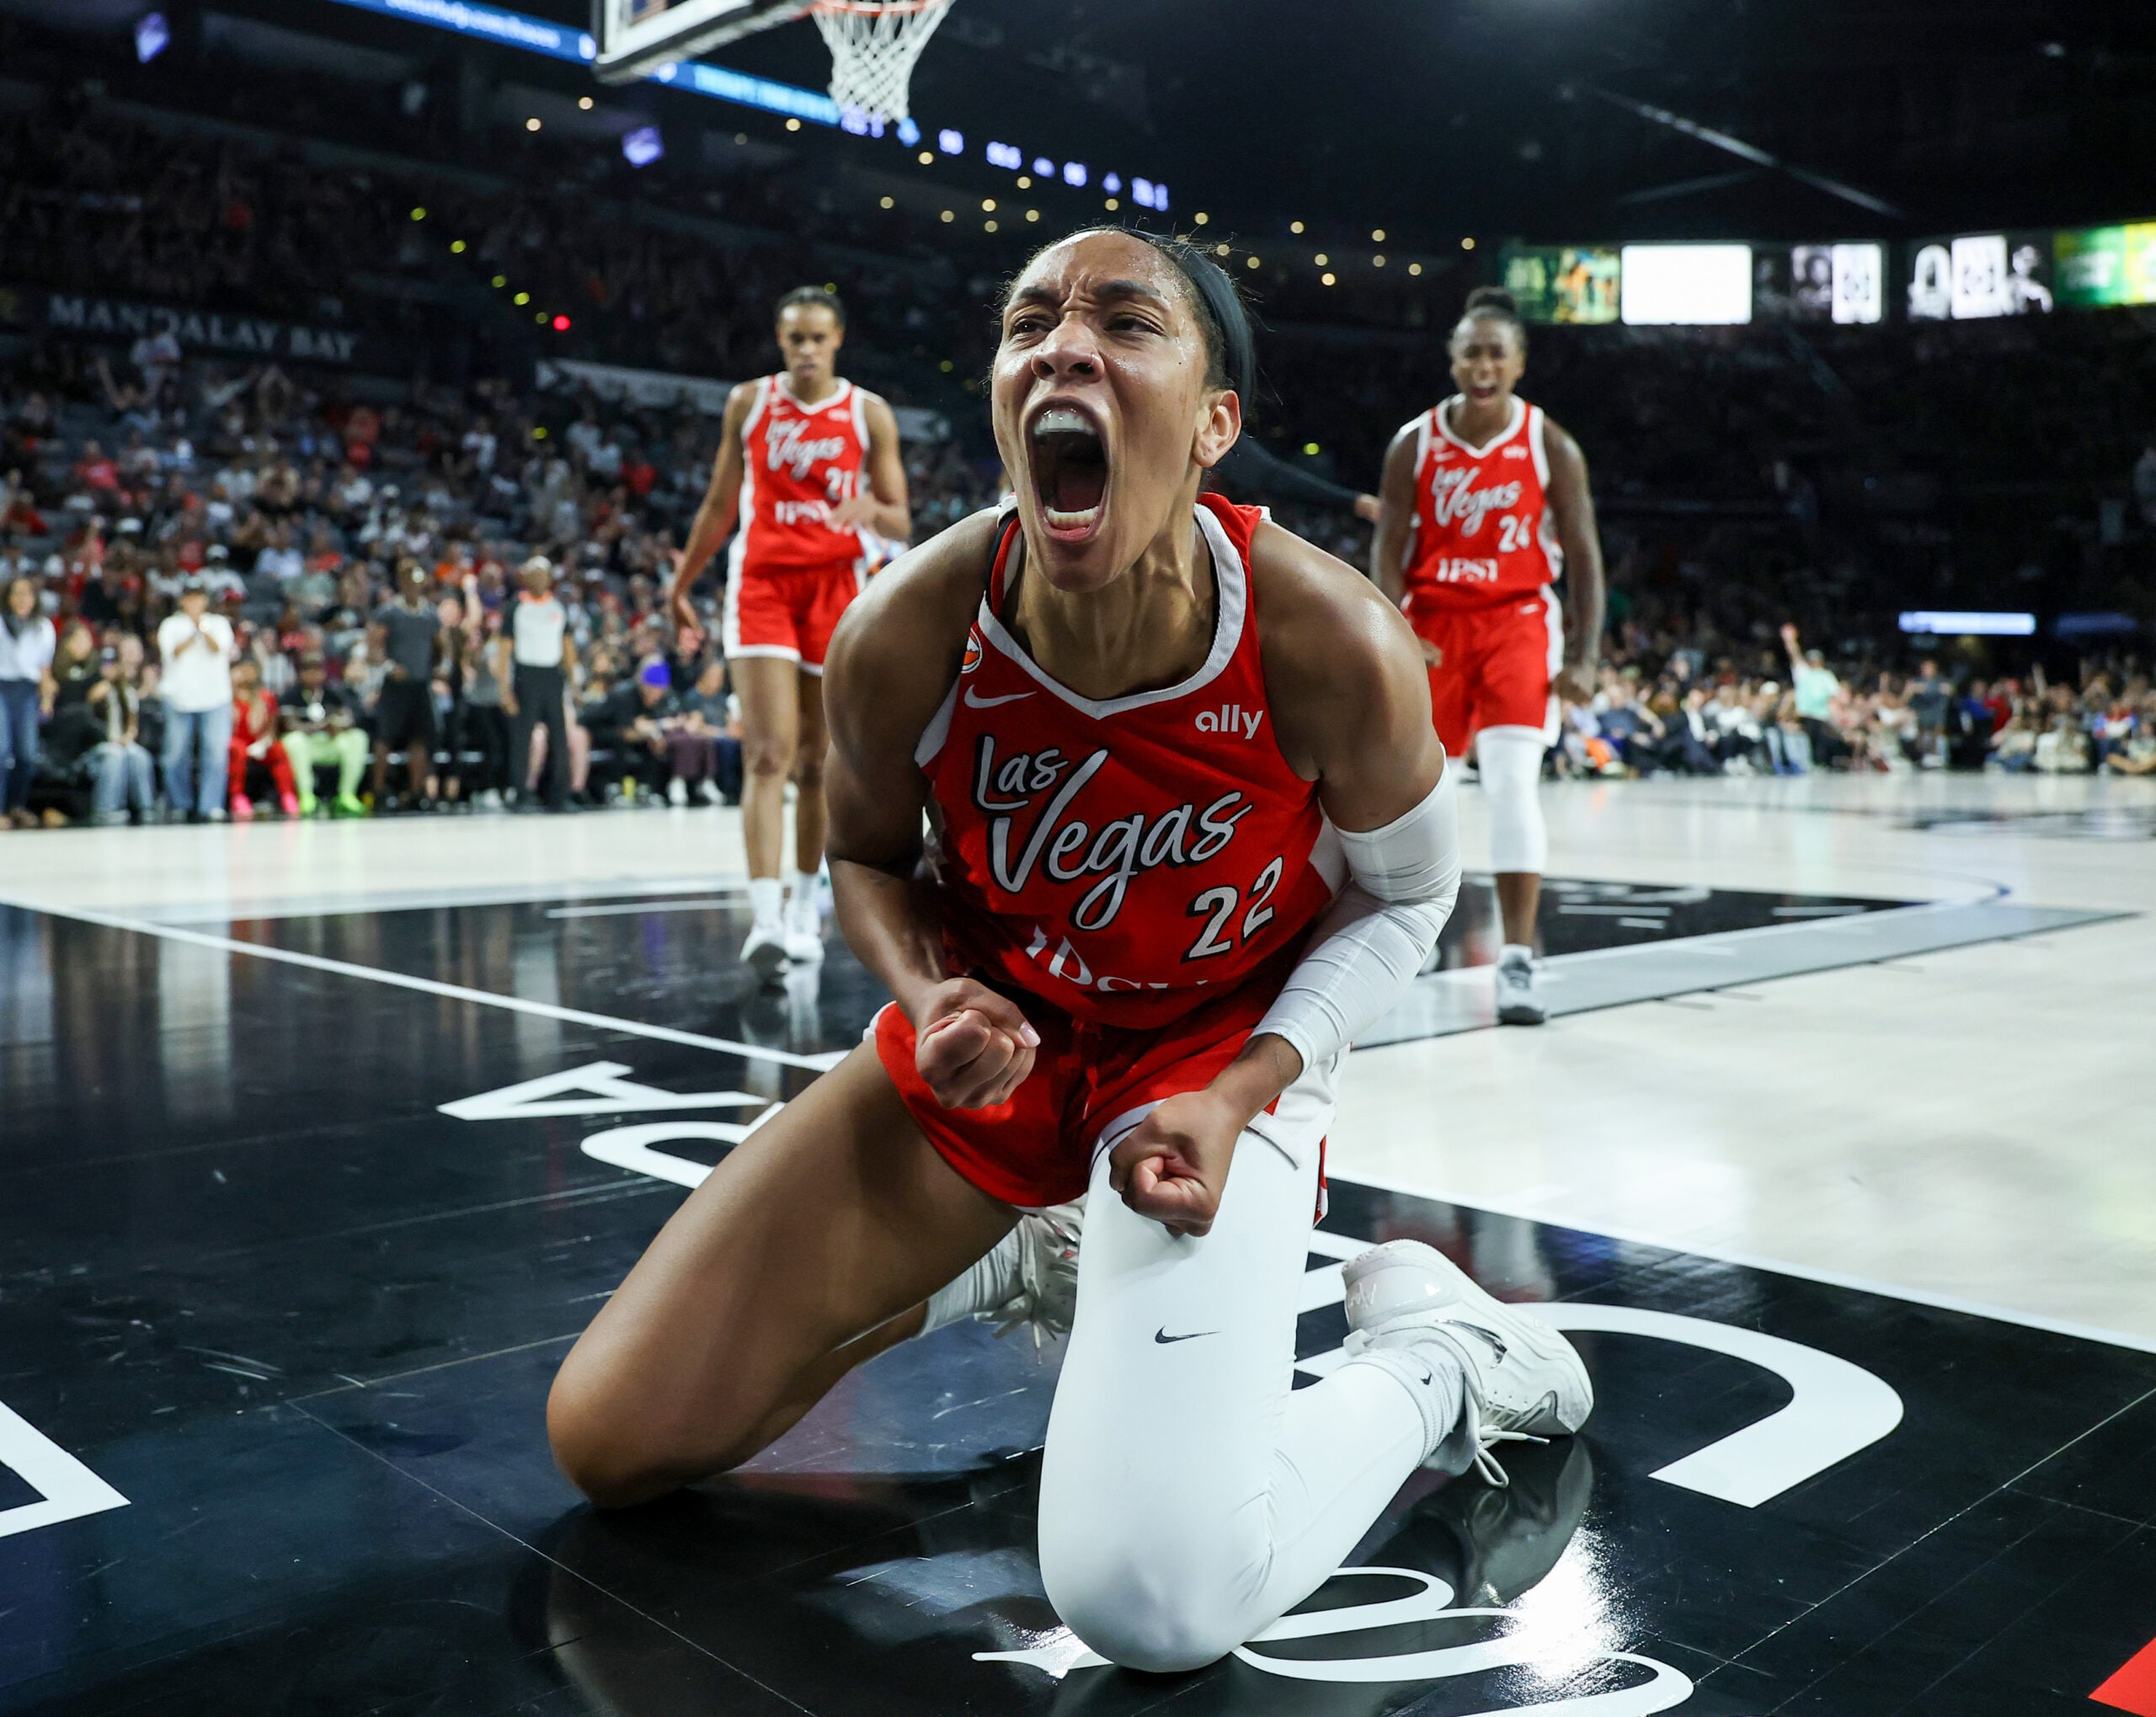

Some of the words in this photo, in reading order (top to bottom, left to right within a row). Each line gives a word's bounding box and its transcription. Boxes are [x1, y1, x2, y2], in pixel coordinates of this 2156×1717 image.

[1434, 466, 1523, 538] Vegas
[1194, 704, 1264, 739] ally
[974, 734, 1070, 811] Las
[990, 748, 1254, 930] Vegas
[1183, 854, 1283, 962] 22
